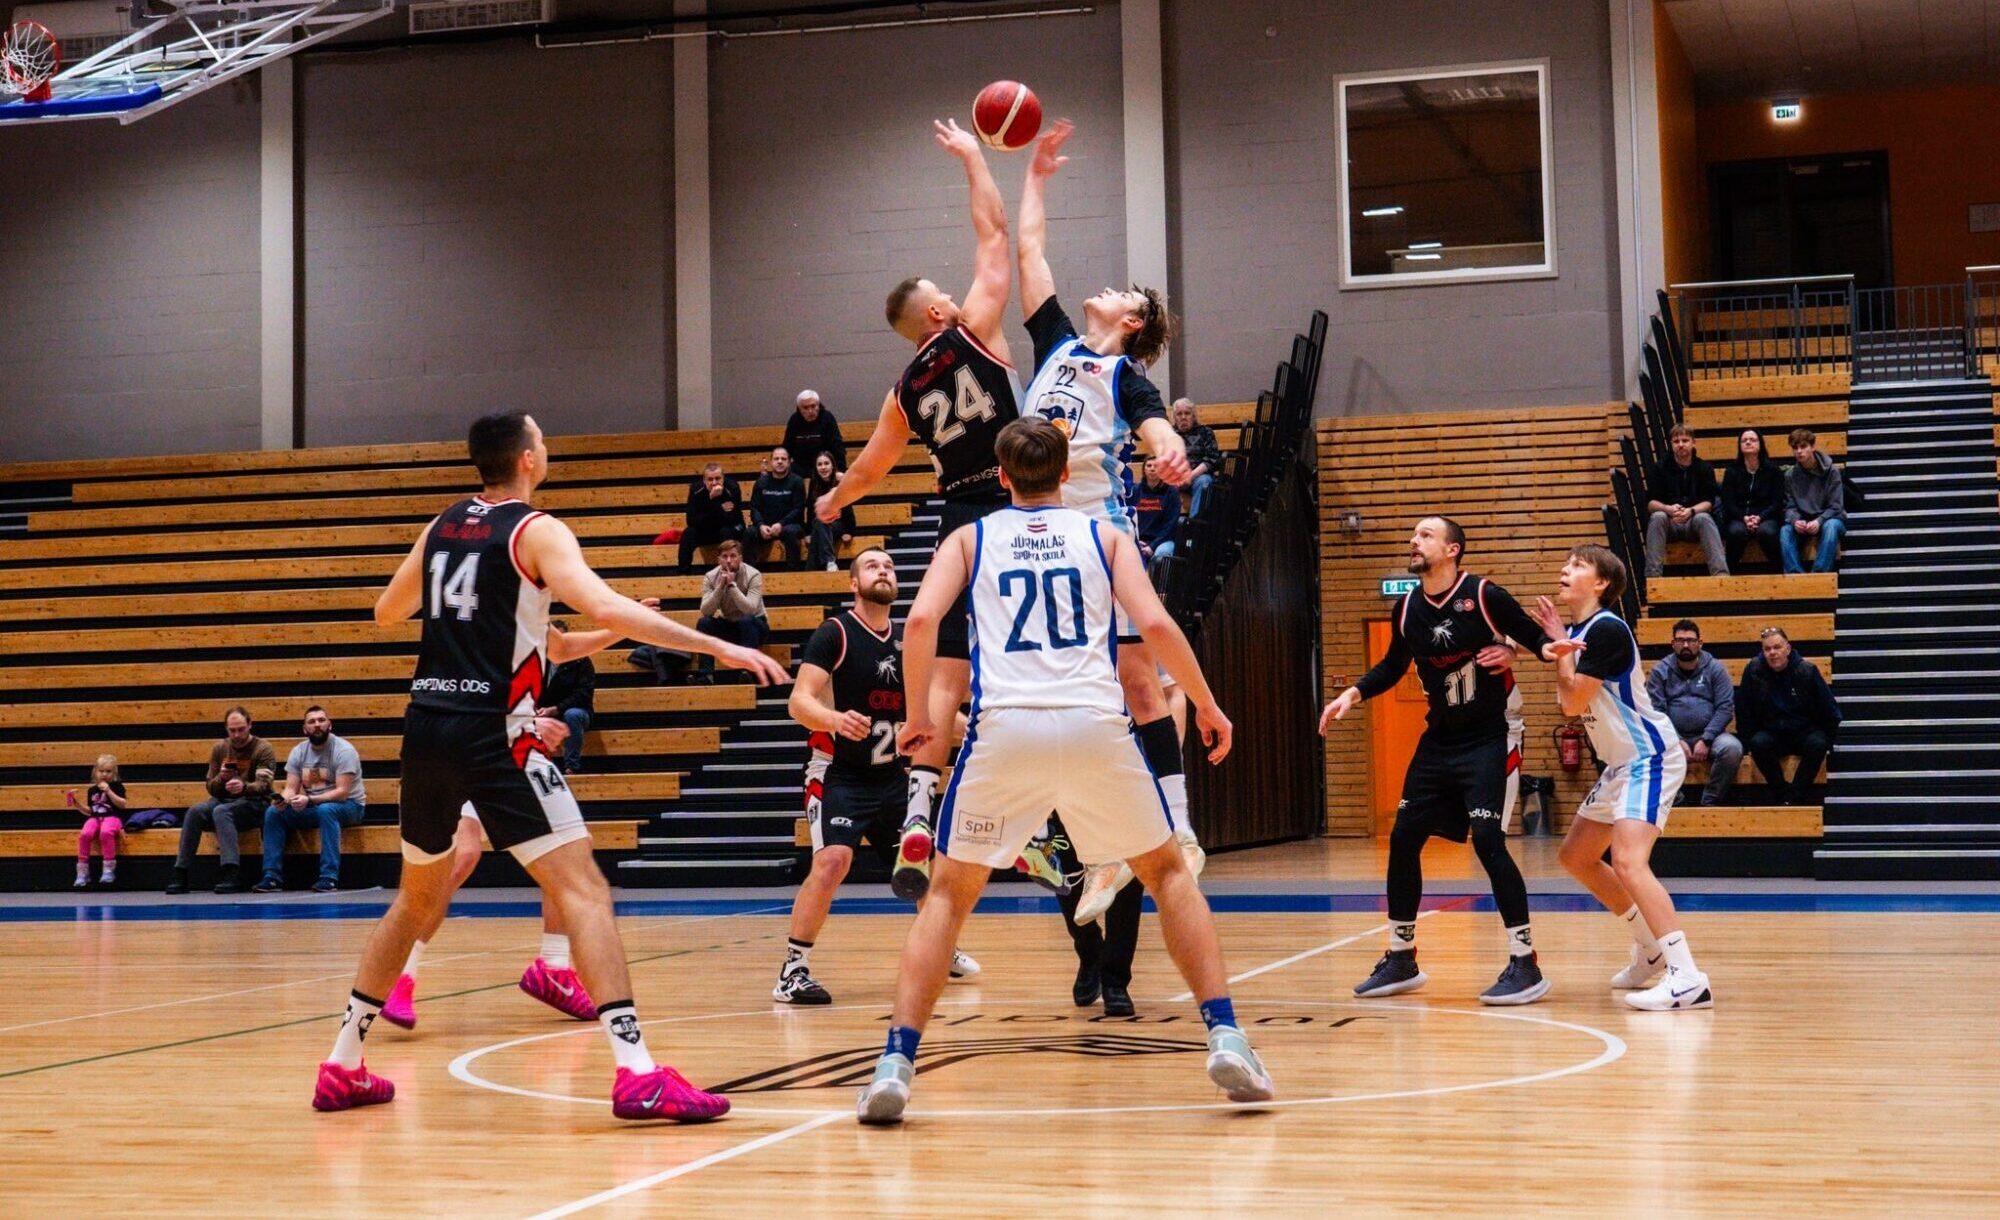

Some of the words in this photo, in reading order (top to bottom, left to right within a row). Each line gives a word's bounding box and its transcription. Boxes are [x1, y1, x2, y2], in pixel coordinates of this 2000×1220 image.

[1055, 364, 1077, 389] 22
[917, 364, 997, 448] 24
[429, 551, 481, 621] 14
[998, 567, 1089, 653] 20
[460, 679, 491, 694] ODS
[1443, 657, 1477, 706] 11
[870, 720, 906, 765] 2
[529, 764, 568, 797] 14
